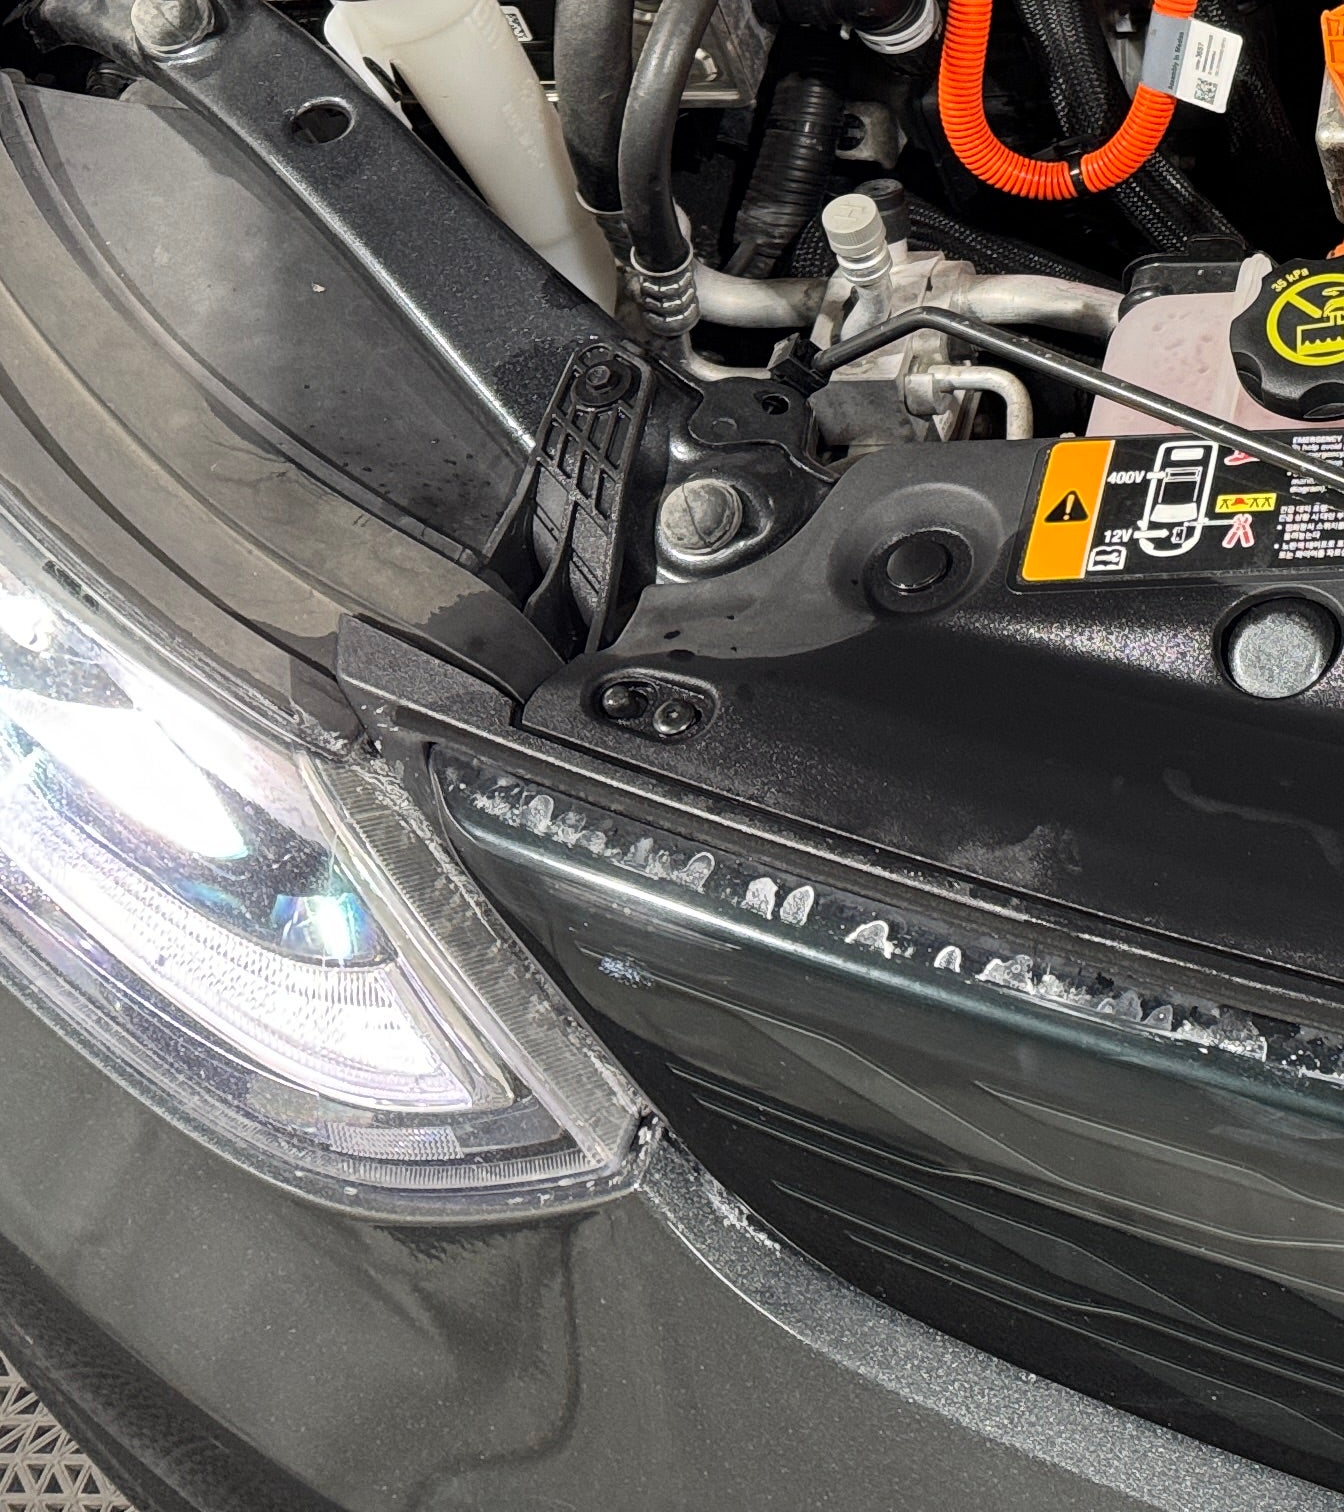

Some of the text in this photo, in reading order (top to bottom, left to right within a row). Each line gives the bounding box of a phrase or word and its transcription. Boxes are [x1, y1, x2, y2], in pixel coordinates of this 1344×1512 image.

[1271, 279, 1288, 293] 35
[1286, 266, 1310, 283] kPa
[1293, 435, 1342, 444] EMERGENCY
[1107, 470, 1145, 484] 400V
[1104, 529, 1133, 541] 12V
